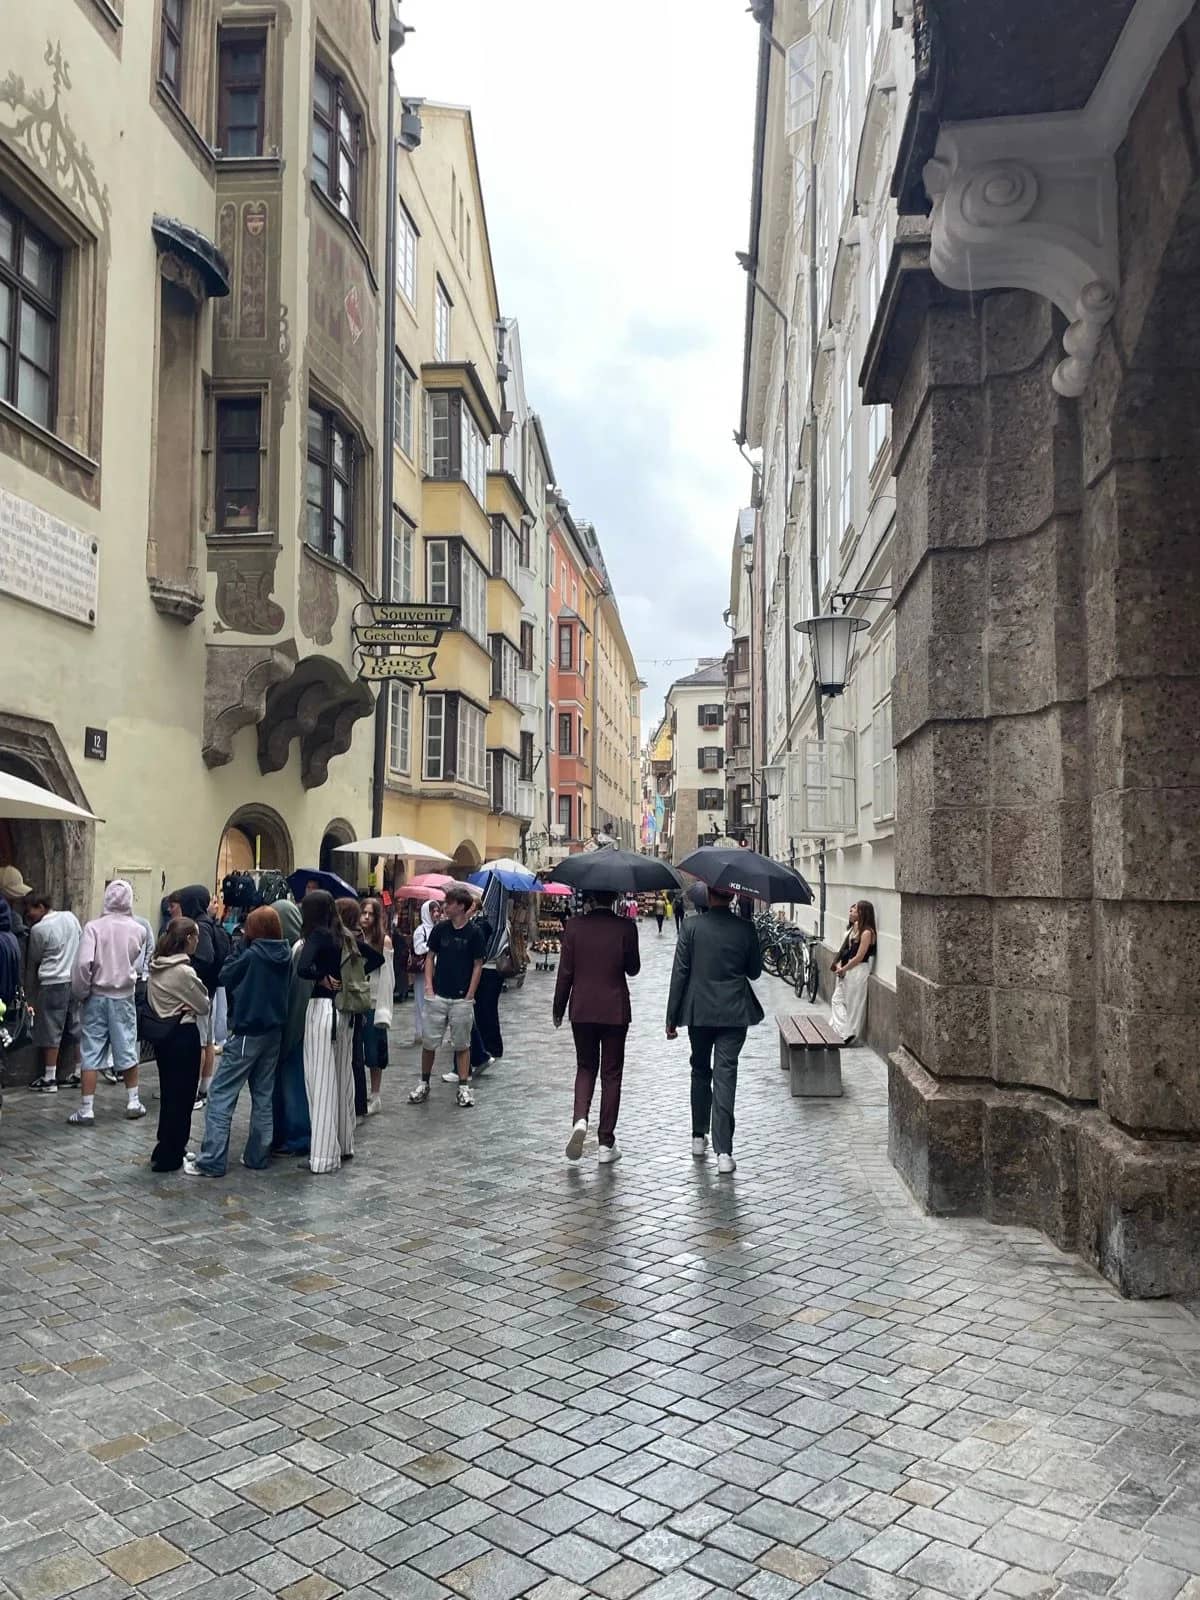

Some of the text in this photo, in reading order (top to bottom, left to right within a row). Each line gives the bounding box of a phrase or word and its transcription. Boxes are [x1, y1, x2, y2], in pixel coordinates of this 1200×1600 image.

[380, 607, 446, 621] Souvenir
[363, 629, 429, 642] Geschenke
[374, 657, 421, 670] Burg
[94, 735, 101, 748] 12
